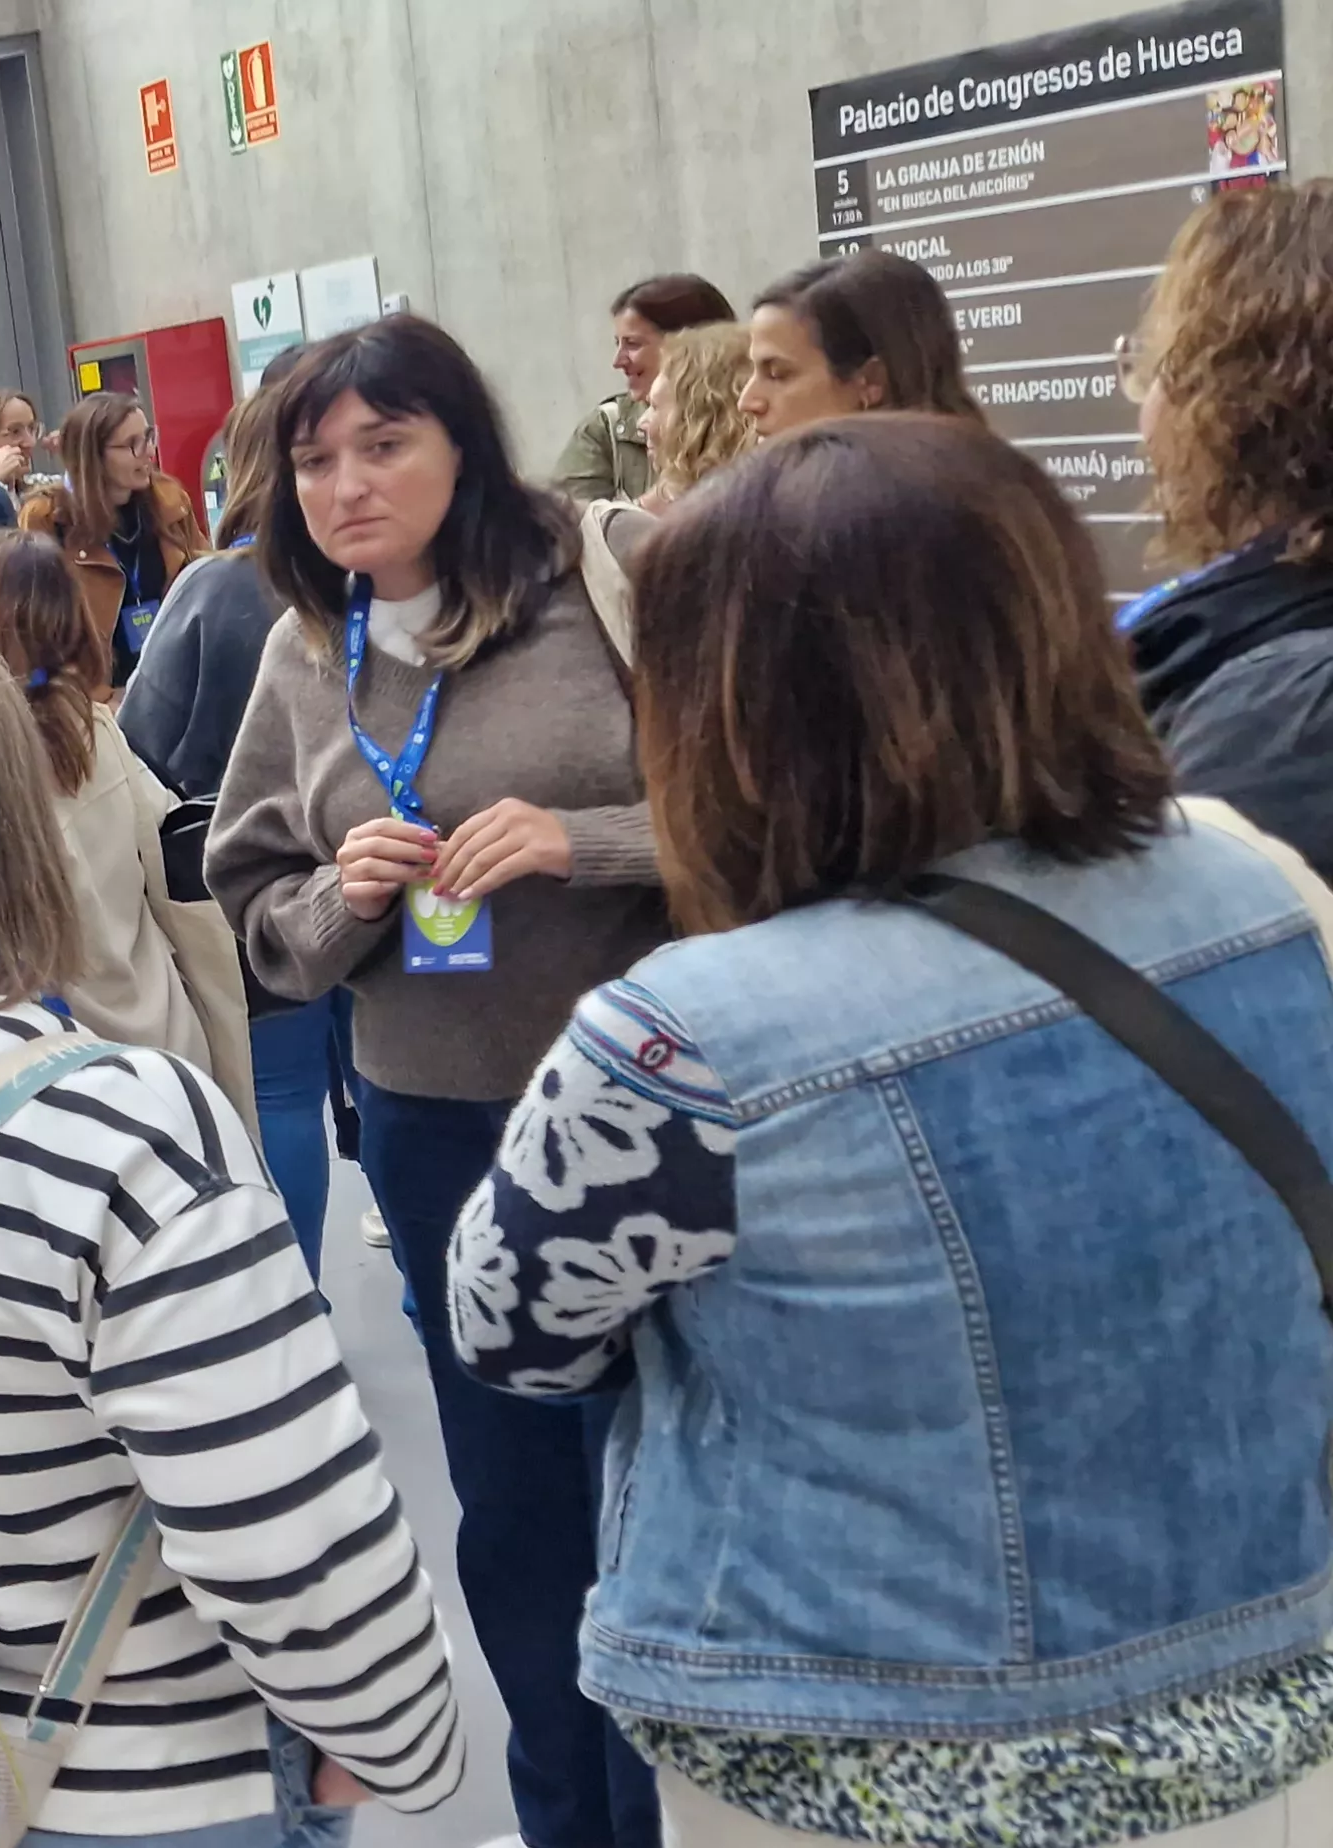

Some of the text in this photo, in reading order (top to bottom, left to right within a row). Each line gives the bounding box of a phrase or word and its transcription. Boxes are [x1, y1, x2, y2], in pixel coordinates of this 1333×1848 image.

[840, 27, 1243, 137] Palacio de Congresos de Huesca
[876, 138, 1045, 191] LA GRANJA DE ZENÓN
[837, 169, 849, 195] 5
[902, 188, 941, 209] BUSCA
[943, 184, 968, 204] DEL
[895, 235, 951, 261] VOCAL
[967, 257, 991, 277] LOS
[968, 303, 1022, 329] VERDI
[992, 376, 1087, 404] RHAPSODY
[1092, 375, 1116, 398] OF
[1111, 456, 1144, 481] gira
